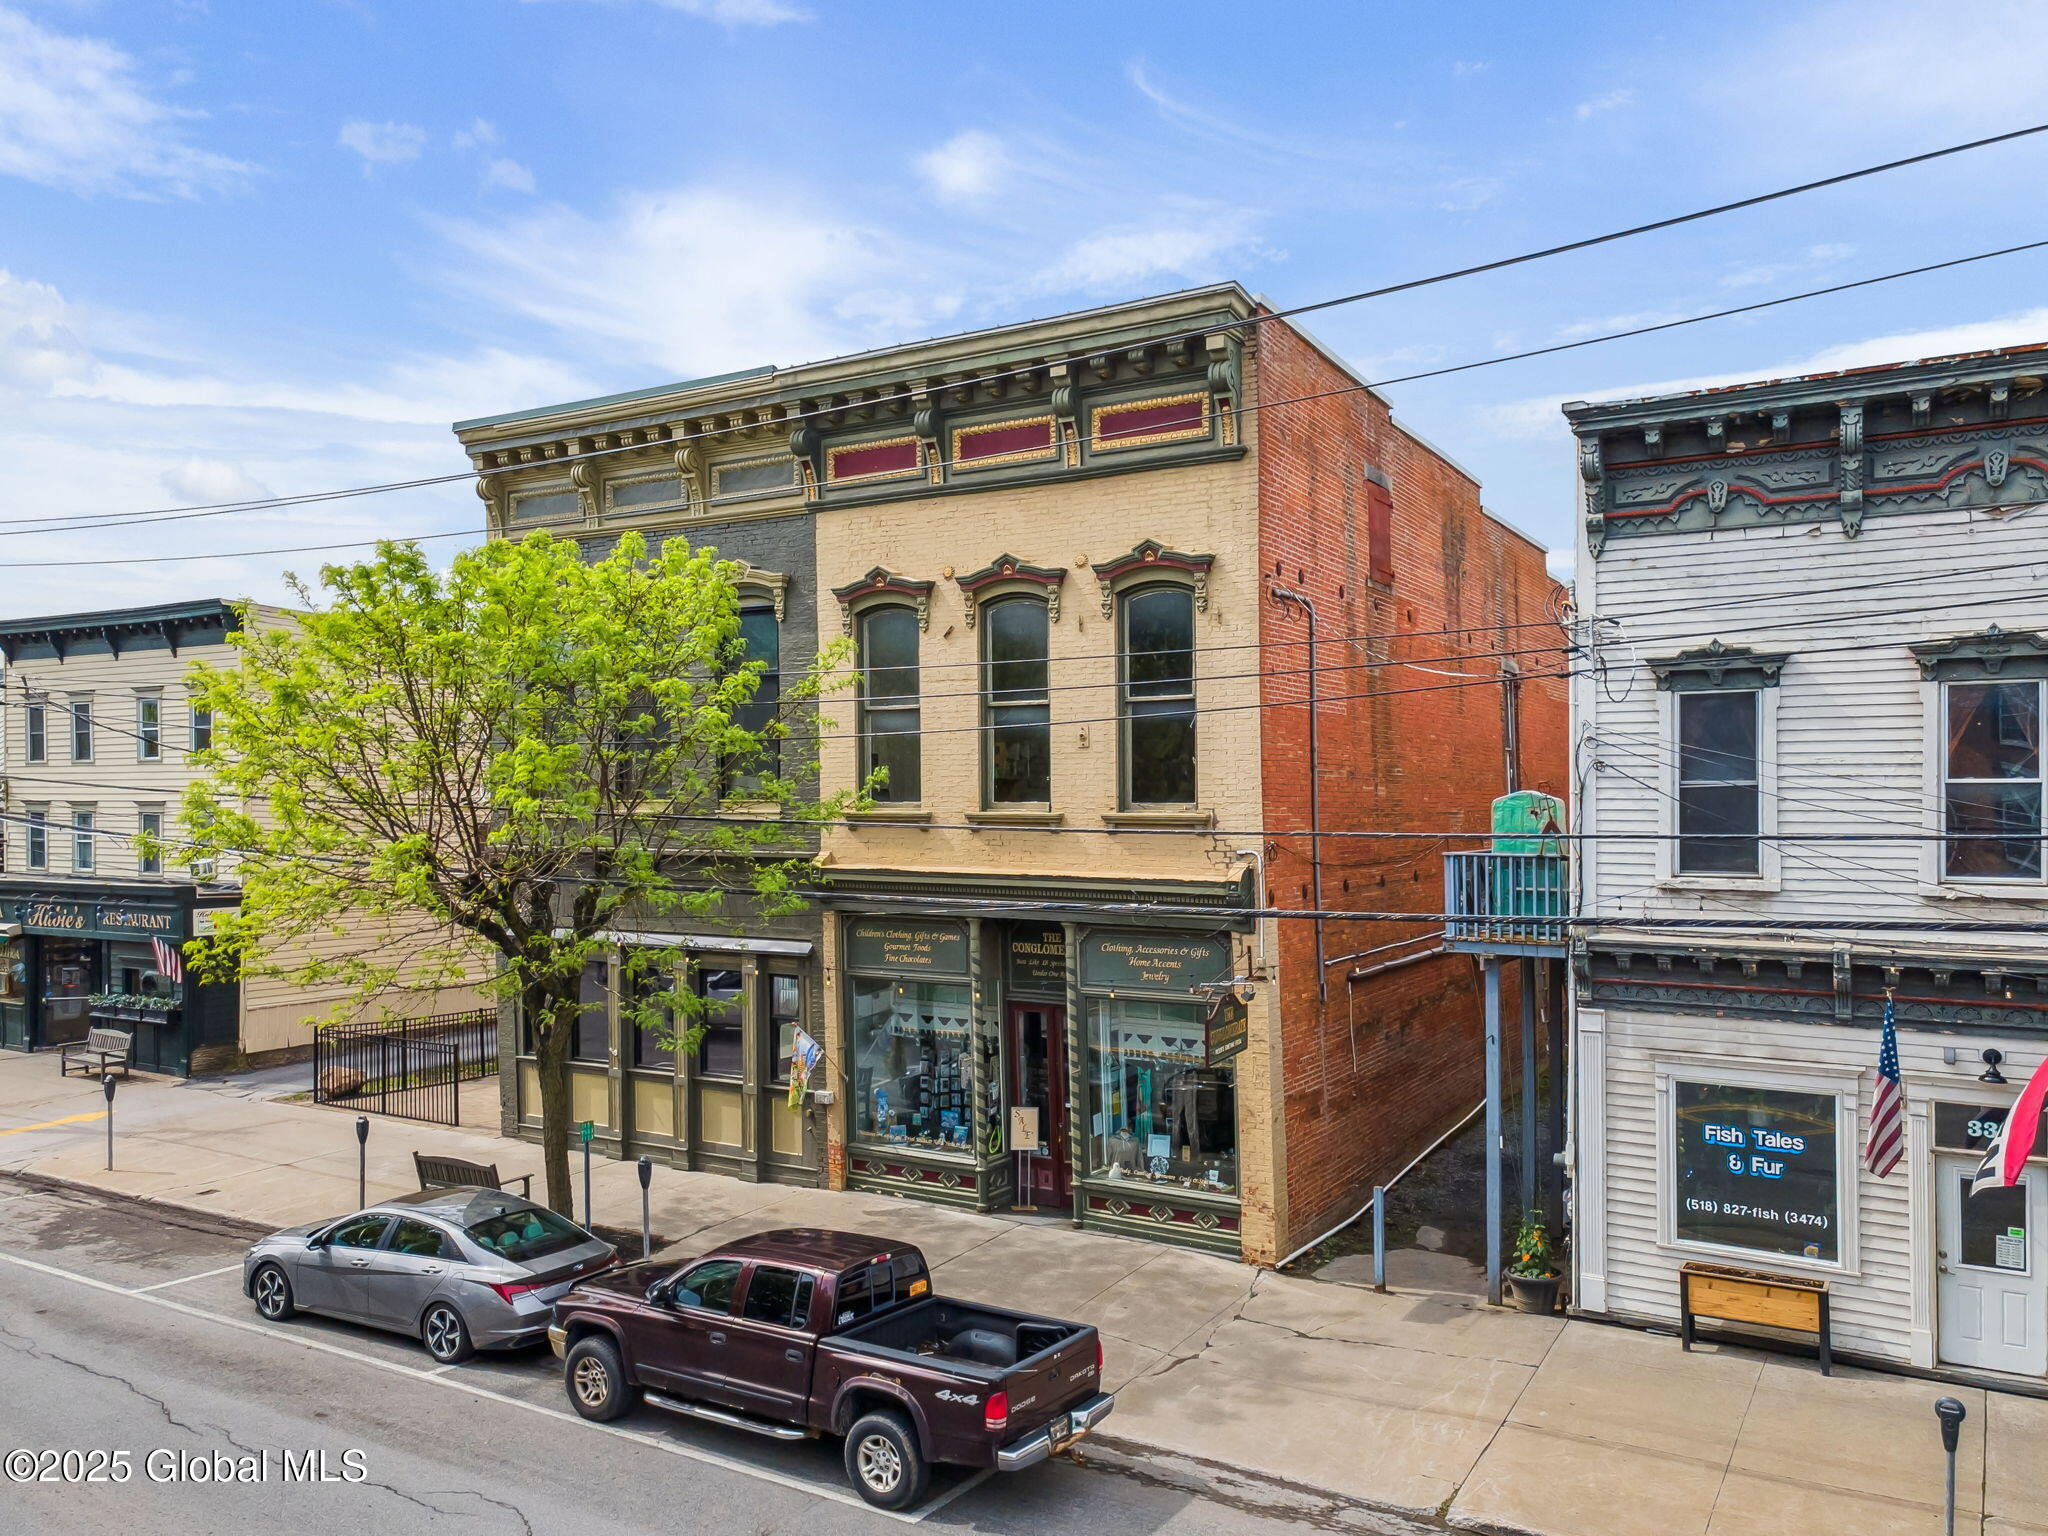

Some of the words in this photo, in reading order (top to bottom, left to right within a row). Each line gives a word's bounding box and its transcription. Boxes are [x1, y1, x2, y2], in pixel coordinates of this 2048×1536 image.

[103, 912, 171, 929] RESAURANT
[856, 928, 885, 938] Children's
[915, 931, 931, 942] Gifts
[940, 933, 960, 943] Games
[1042, 933, 1061, 943] THE
[884, 943, 910, 952] Gourmet
[913, 943, 931, 952] Foods
[1012, 942, 1066, 956] CONGLOME
[1101, 942, 1134, 956] Clothing,
[1135, 944, 1178, 956] Accessories
[1180, 947, 1189, 955] &
[1190, 946, 1210, 960] Gifts
[885, 953, 898, 963] Fine
[899, 953, 932, 964] Chocolates
[1128, 956, 1151, 967] Home
[1151, 958, 1182, 969] Accents
[1140, 970, 1170, 985] Jewelry
[1704, 1123, 1745, 1147] Fish
[1752, 1129, 1806, 1153] Tales
[1728, 1154, 1743, 1173] &
[1750, 1155, 1784, 1178] Fur
[1686, 1197, 1718, 1214] (518)
[1723, 1203, 1779, 1220] 827-fish
[1784, 1210, 1828, 1229] (3474)
[1069, 1363, 1095, 1381] DAKOTA
[934, 1389, 980, 1406] 4x4
[1011, 1395, 1036, 1414] DODGE
